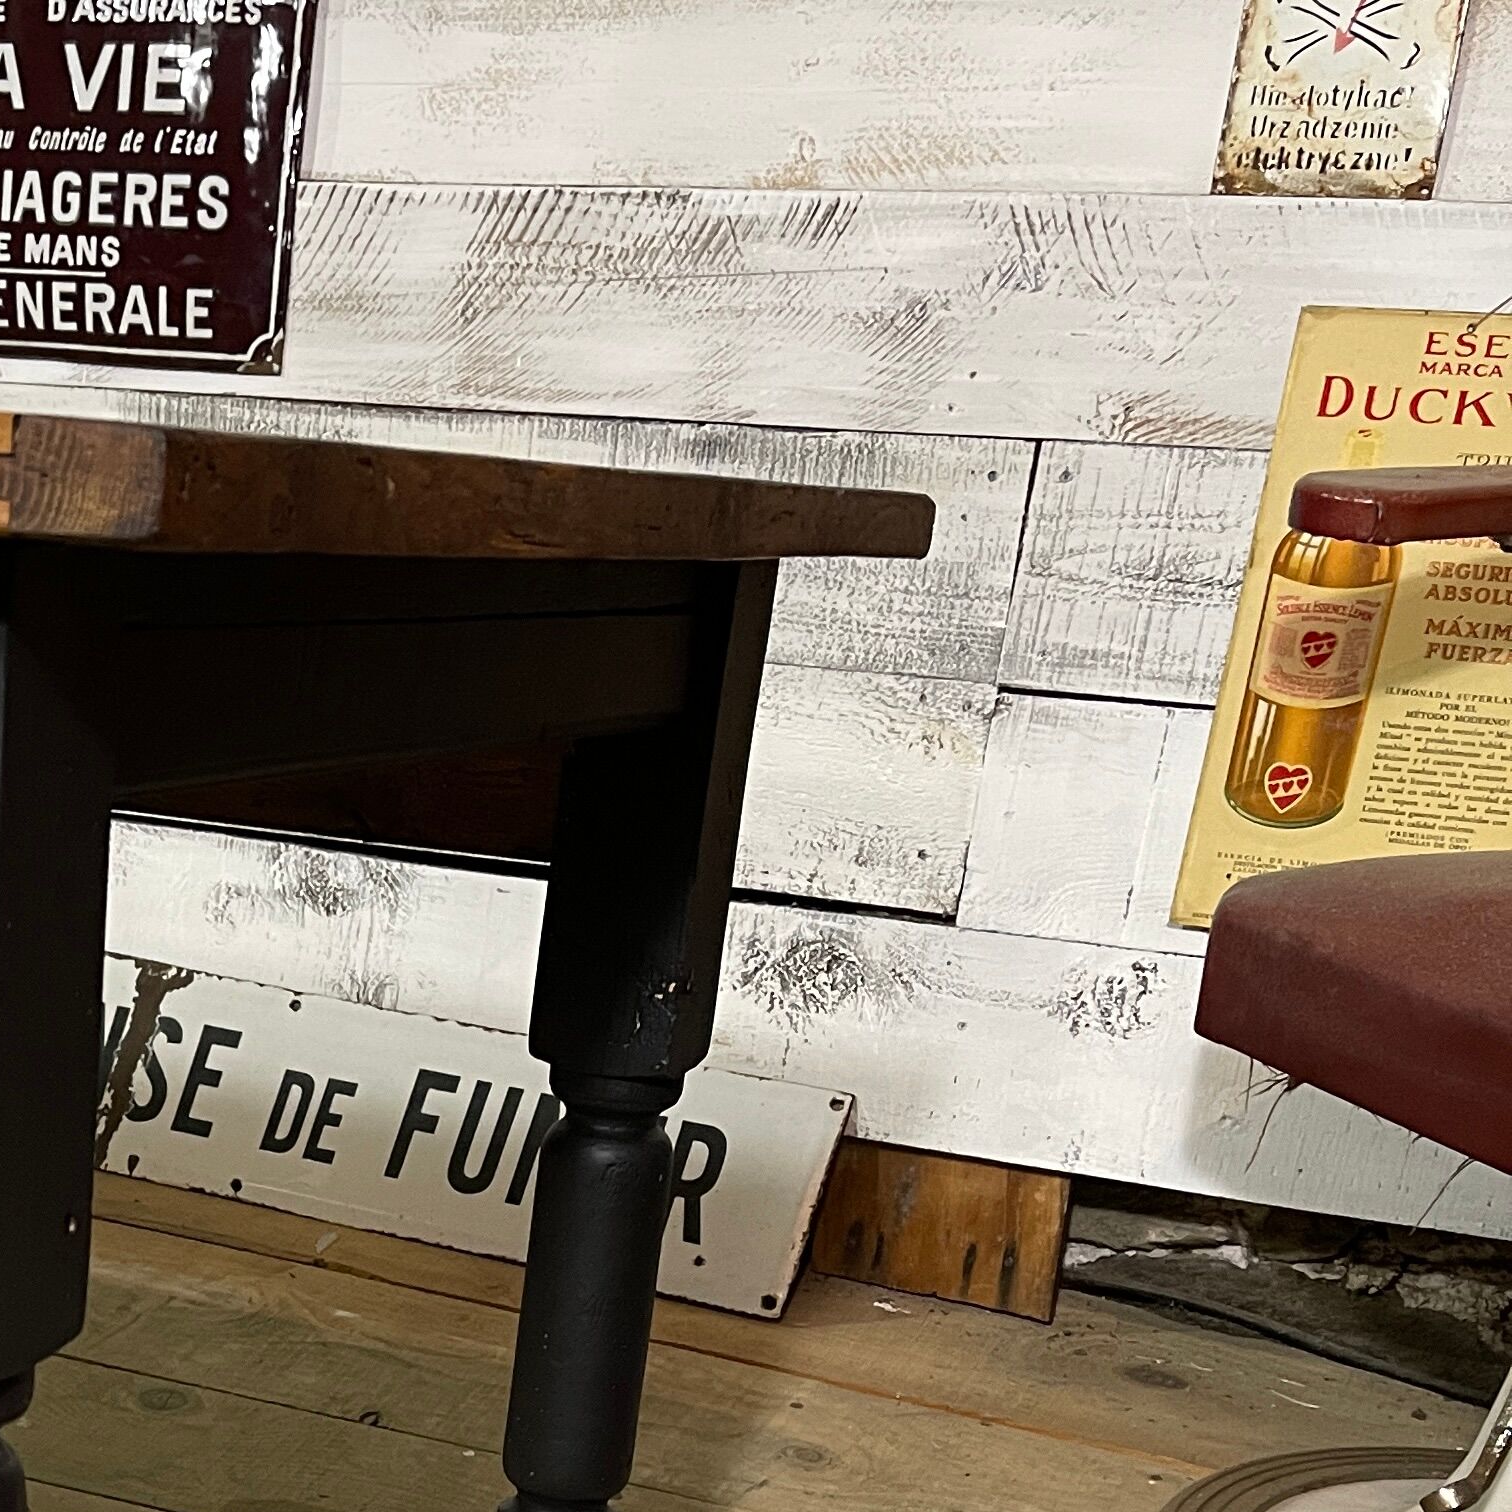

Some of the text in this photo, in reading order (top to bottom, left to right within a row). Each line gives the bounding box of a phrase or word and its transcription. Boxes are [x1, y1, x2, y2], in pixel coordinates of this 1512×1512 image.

[47, 0, 262, 25] DASSURANCES
[64, 42, 192, 114] VIE
[28, 126, 107, 152] Contrôle
[119, 128, 144, 152] de
[154, 127, 217, 155] l'Etat
[25, 233, 120, 267] MANS
[1424, 331, 1511, 359] ESE
[1418, 361, 1504, 378] MARCA
[1316, 375, 1512, 428] DUCK
[259, 1069, 358, 1164] DE
